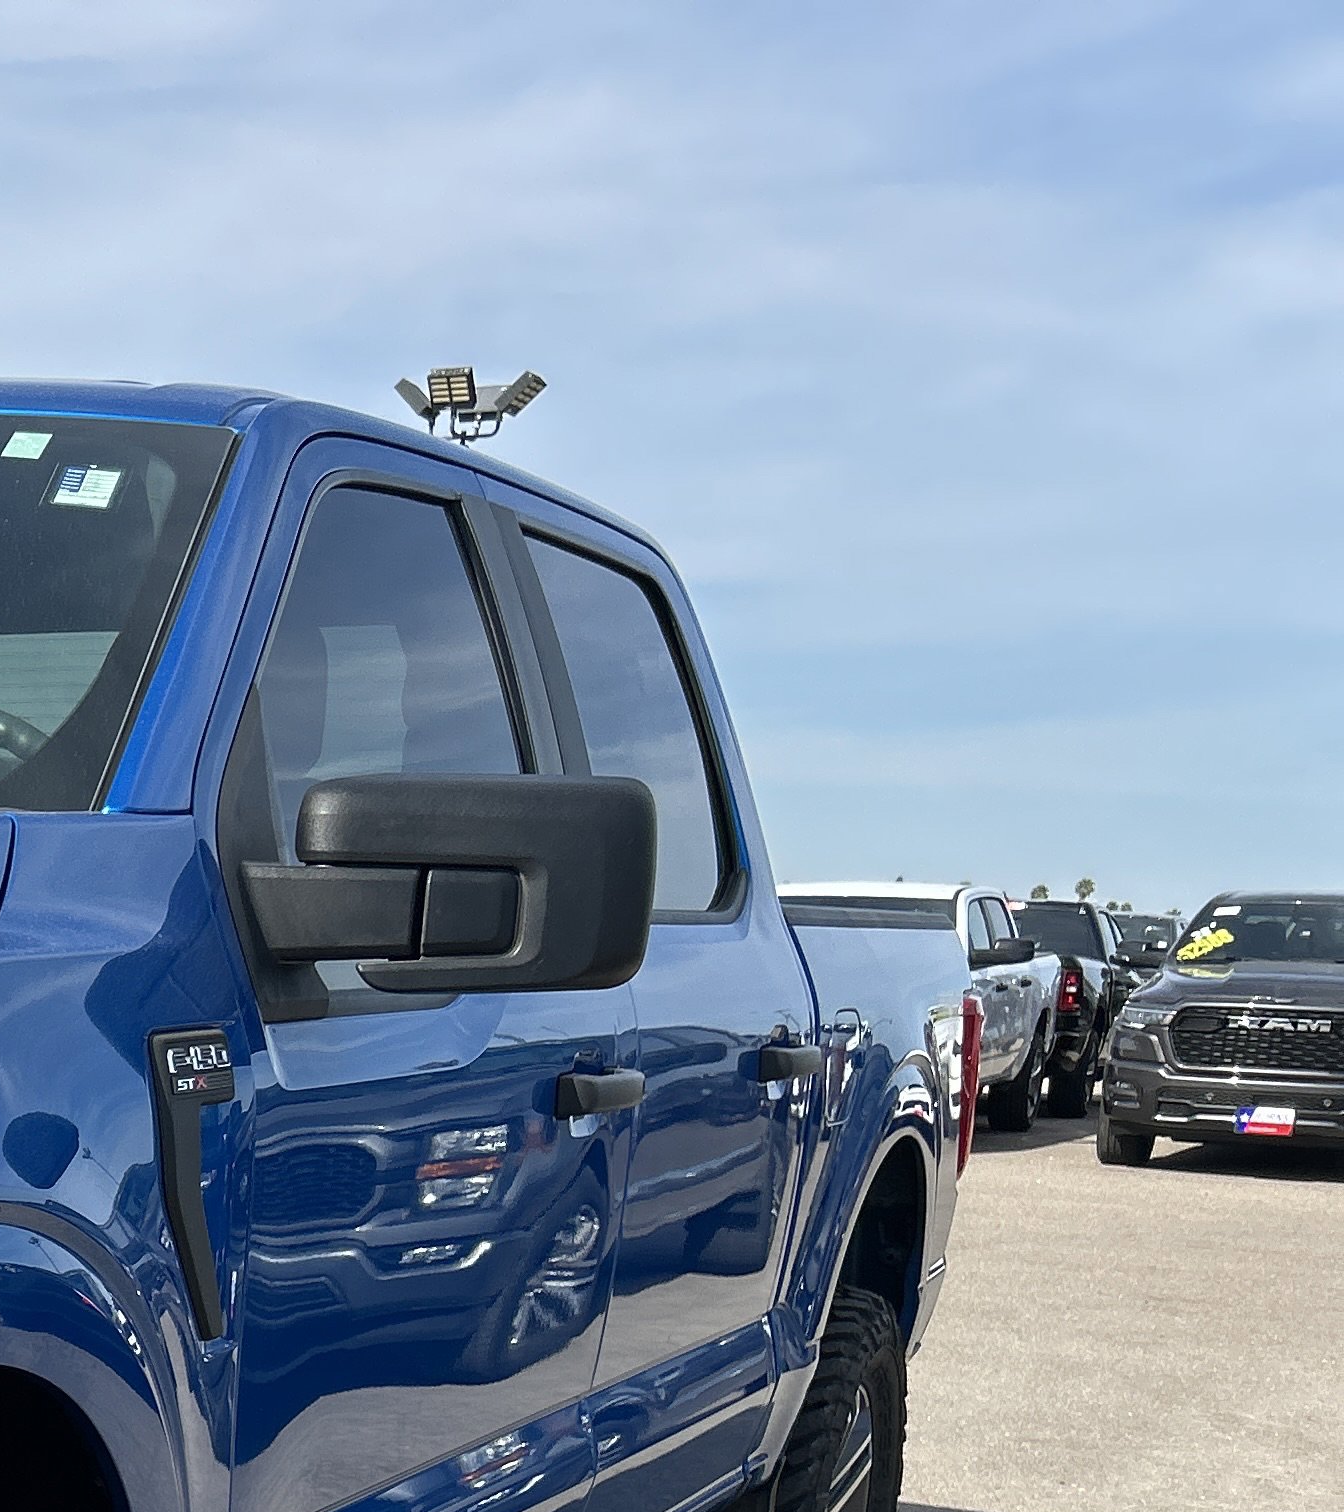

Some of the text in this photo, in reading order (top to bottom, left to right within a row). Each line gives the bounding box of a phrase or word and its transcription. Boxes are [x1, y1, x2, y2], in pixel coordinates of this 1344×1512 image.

[1227, 1015, 1332, 1033] RAM
[167, 1044, 231, 1074] F-150
[177, 1075, 208, 1092] STX
